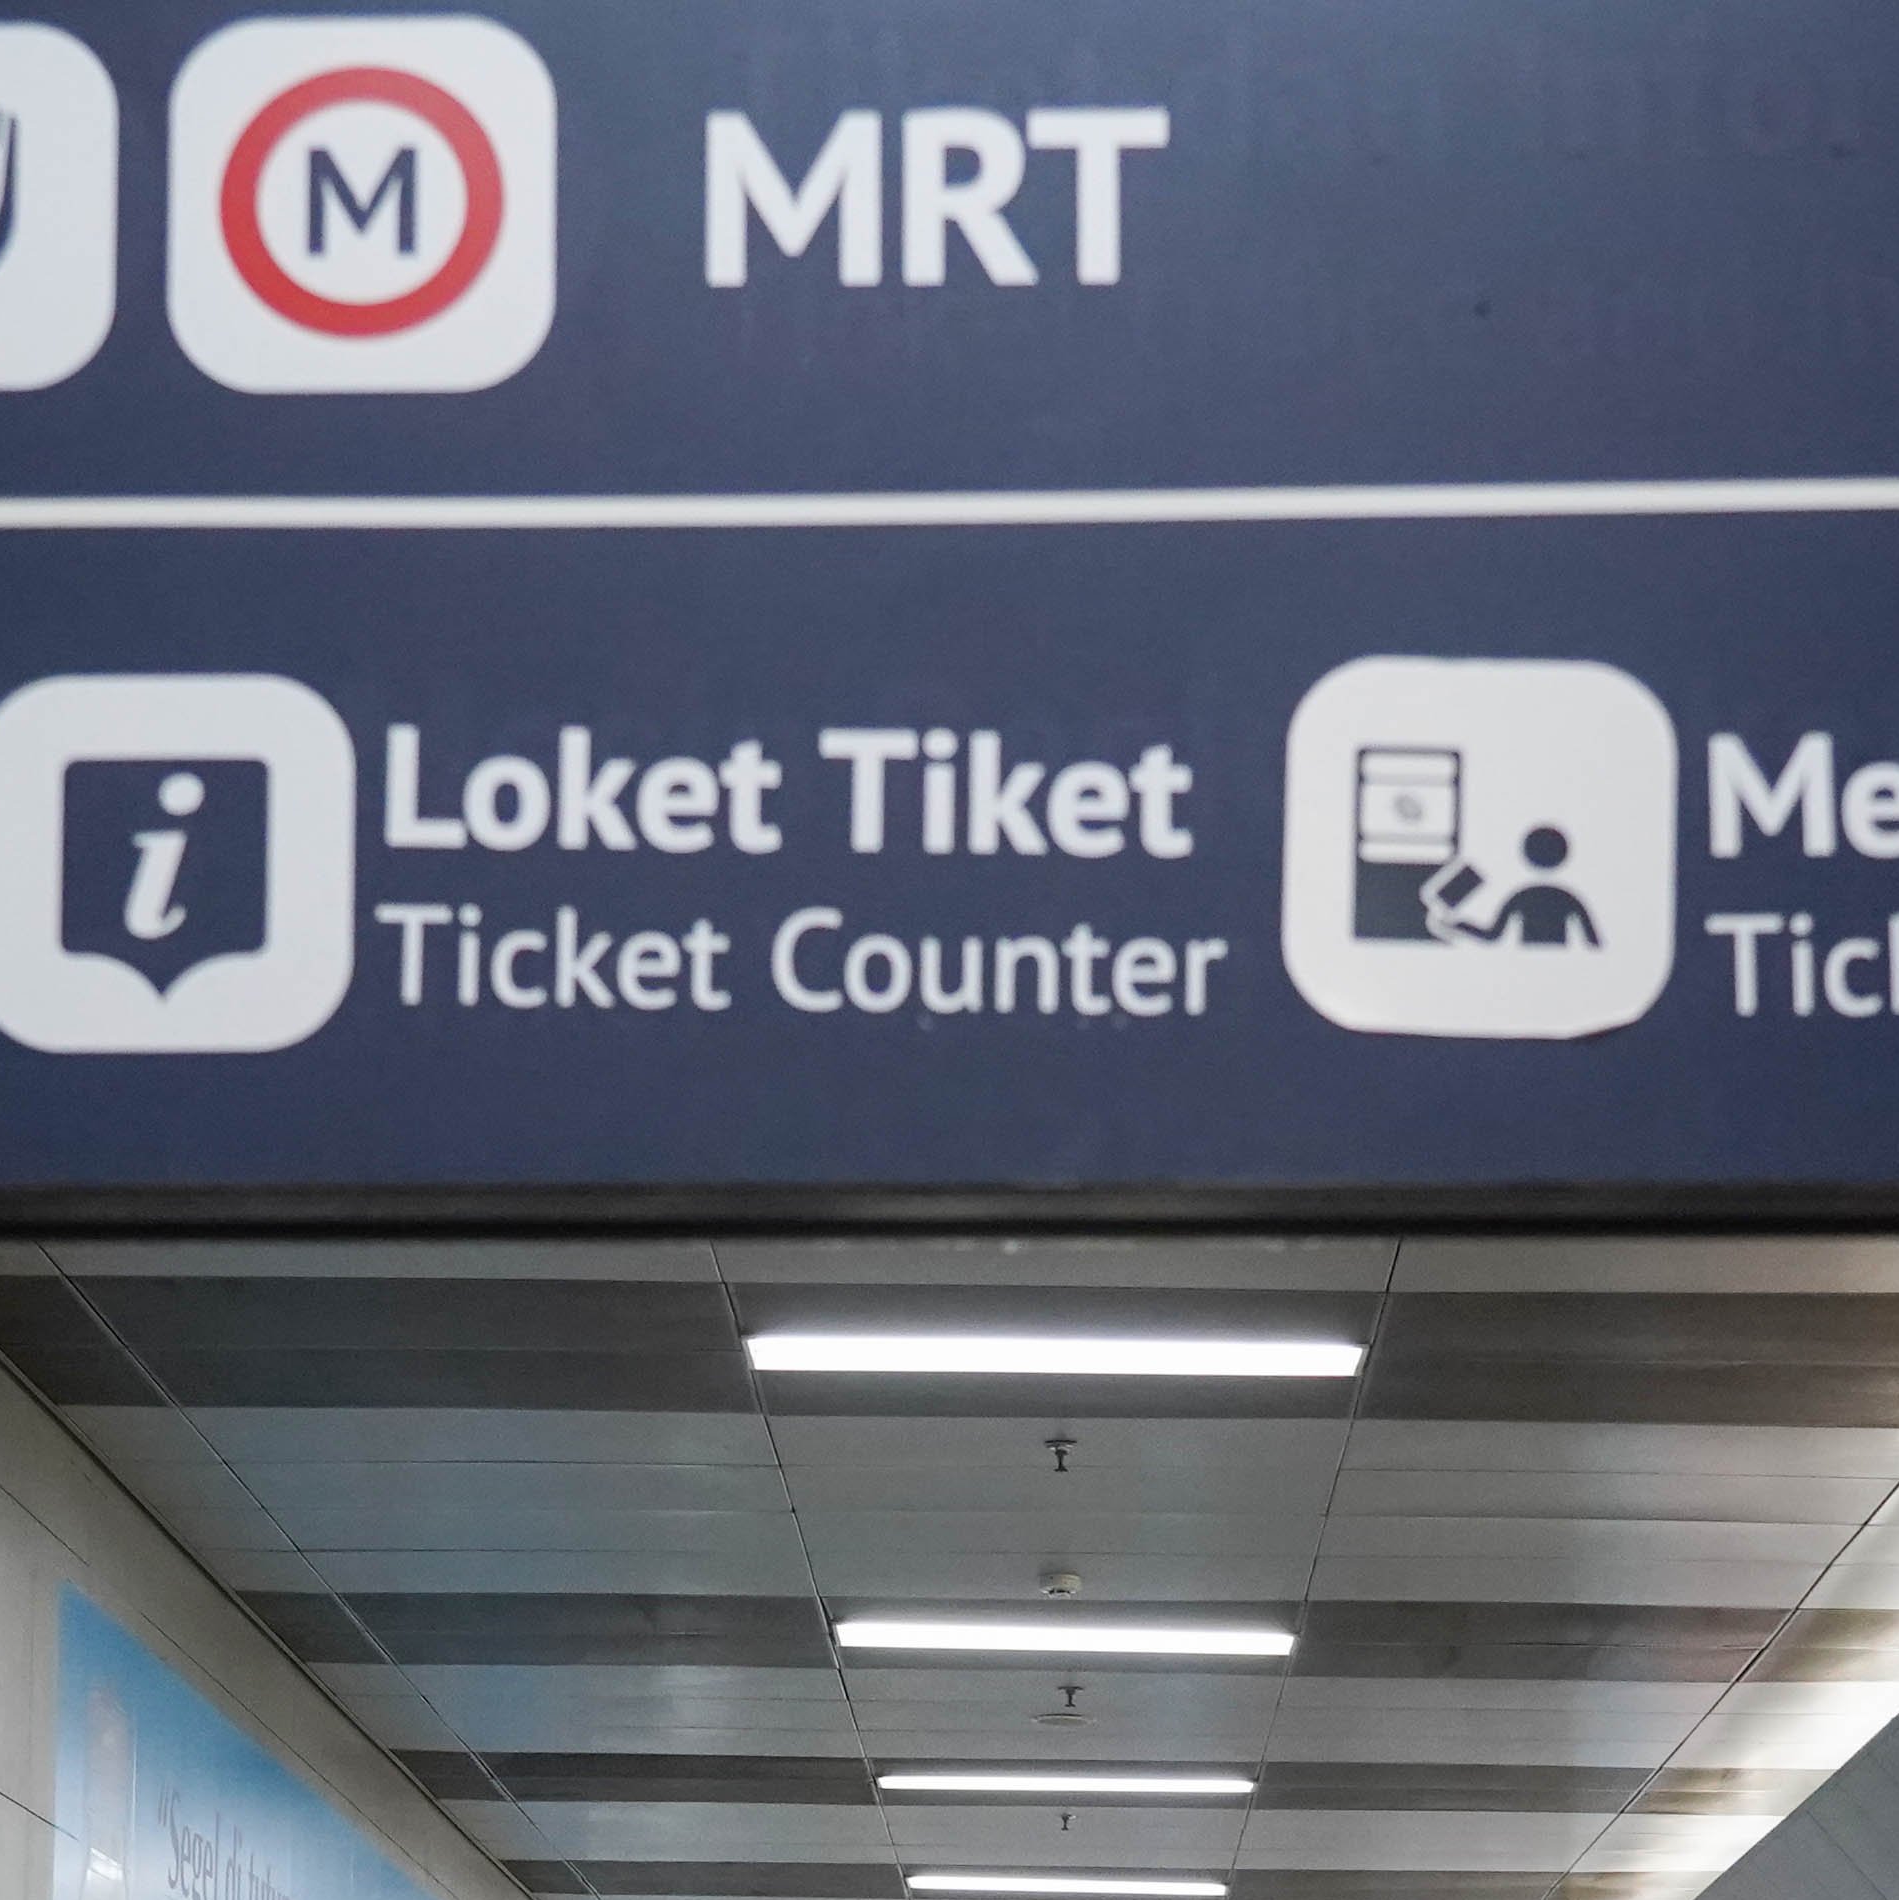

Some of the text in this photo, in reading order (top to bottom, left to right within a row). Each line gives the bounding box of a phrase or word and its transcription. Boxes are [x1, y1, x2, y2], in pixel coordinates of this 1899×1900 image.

[703, 104, 1171, 289] MRT
[383, 722, 1194, 859] Loket Tiket
[374, 902, 1229, 1017] Ticket Counter
